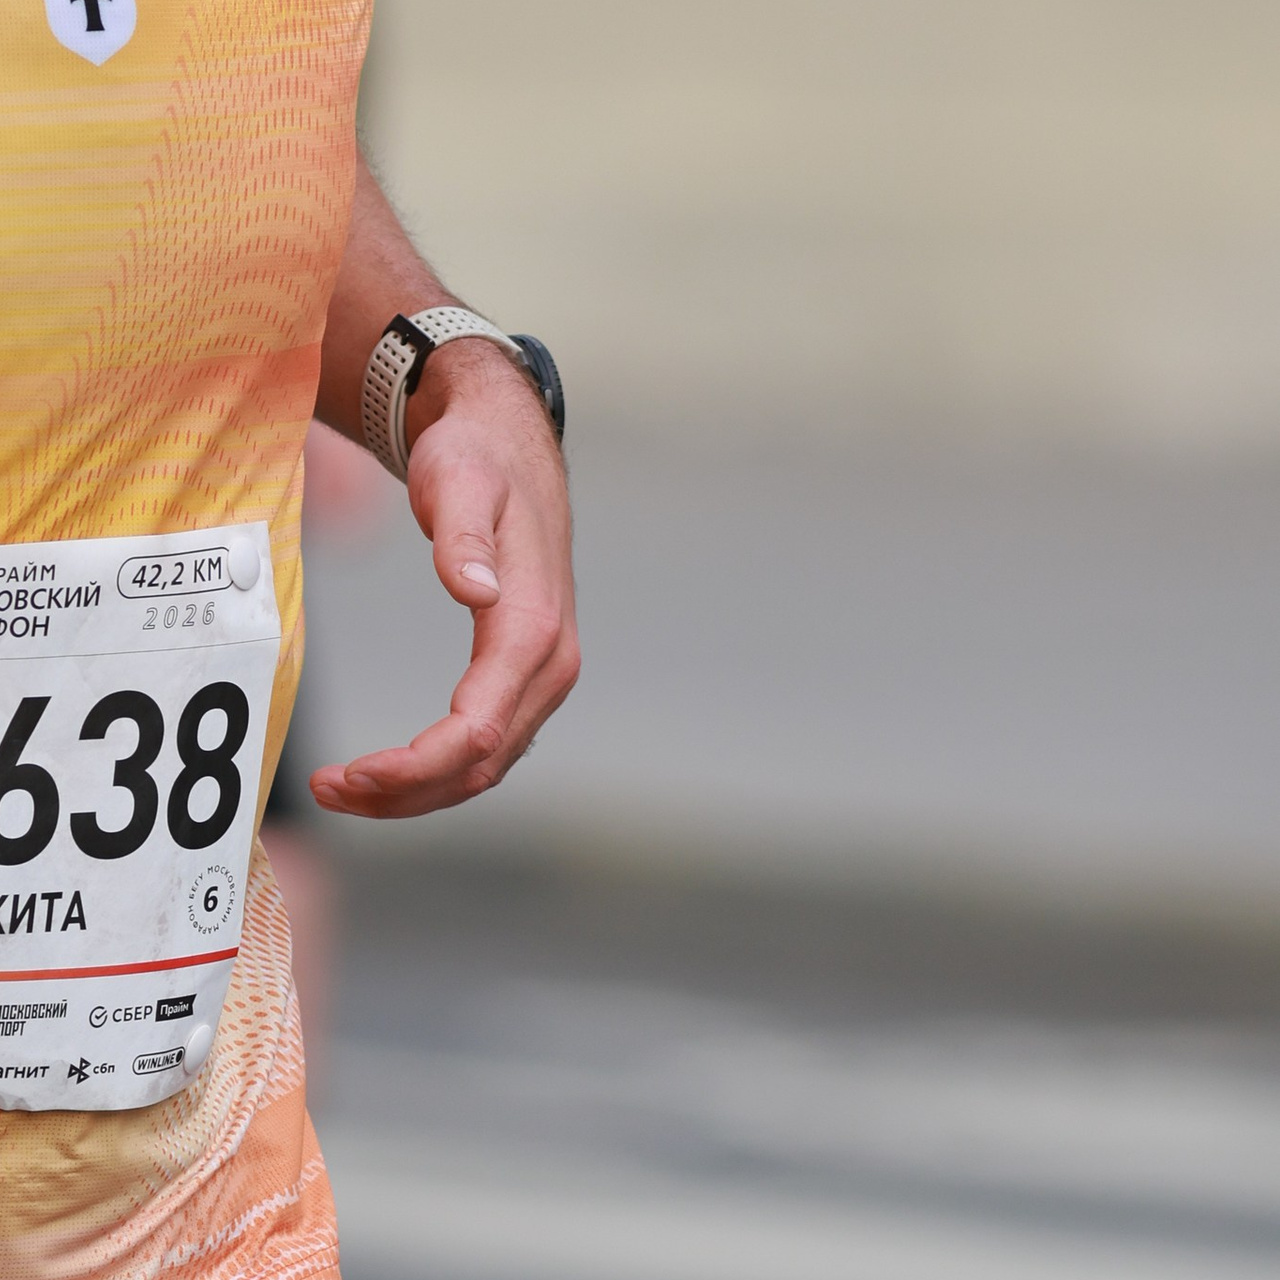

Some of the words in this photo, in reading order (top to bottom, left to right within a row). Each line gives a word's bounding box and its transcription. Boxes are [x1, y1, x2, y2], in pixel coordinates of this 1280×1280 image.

[132, 562, 184, 590] 42,2
[193, 556, 222, 583] КМ
[142, 601, 215, 630] 2026
[203, 885, 218, 913] 6
[112, 1005, 153, 1023] СБЕР
[160, 1001, 190, 1016] Прайм
[93, 1063, 115, 1074] сбп
[137, 1053, 176, 1071] WINLINE
